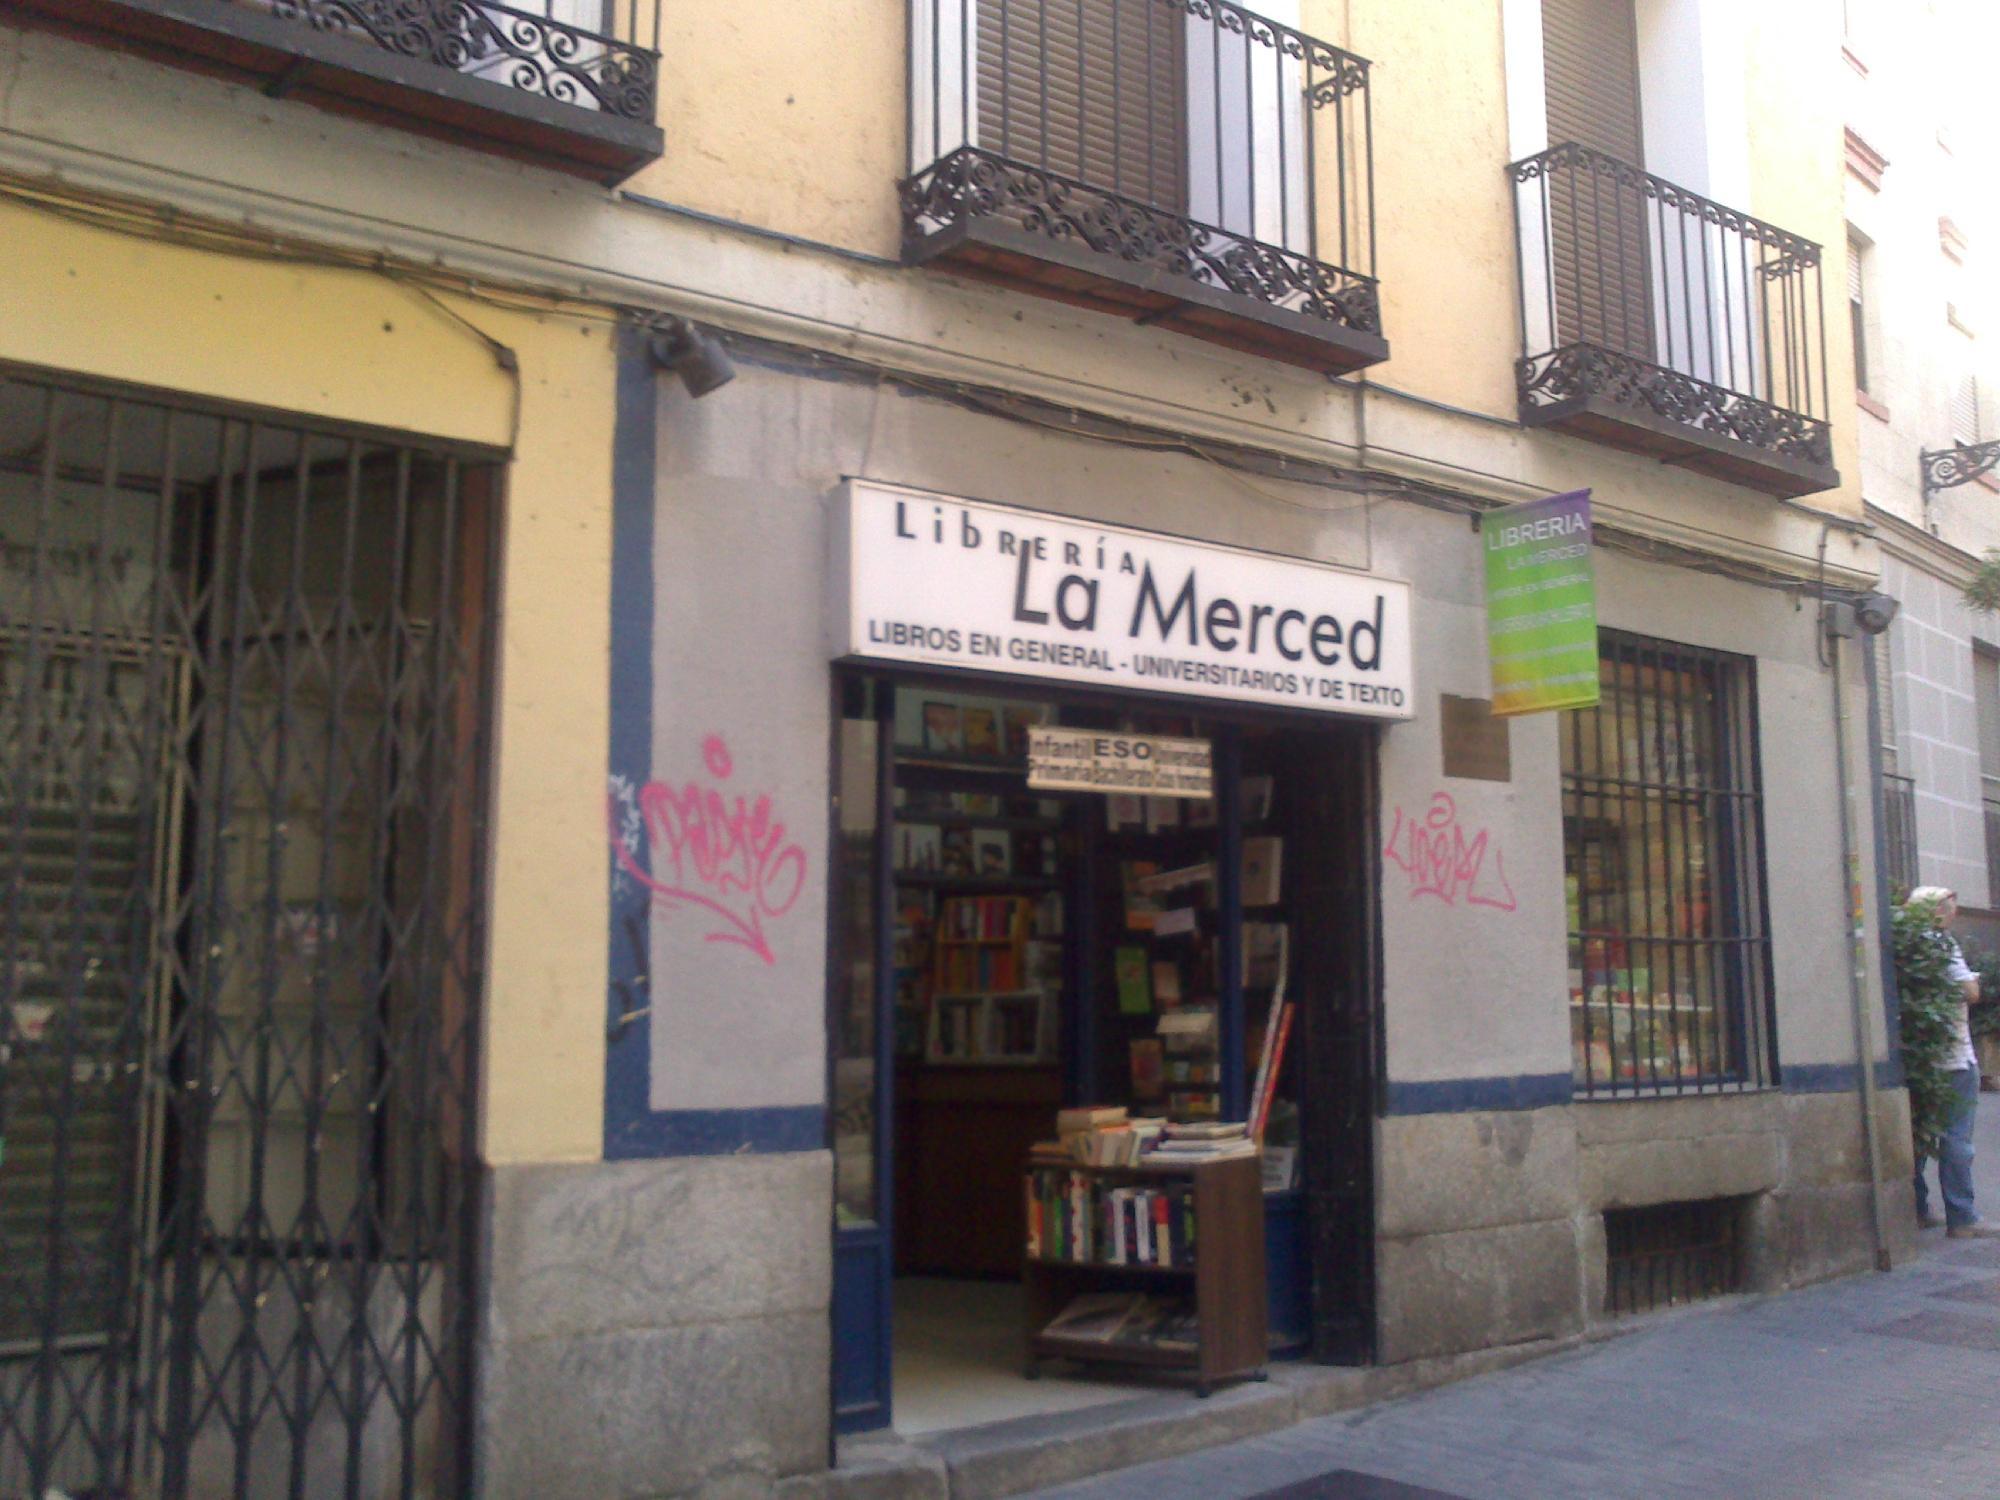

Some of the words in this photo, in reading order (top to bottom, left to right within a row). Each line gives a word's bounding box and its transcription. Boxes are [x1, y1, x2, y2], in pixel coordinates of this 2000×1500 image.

[1488, 512, 1587, 551] LIBRERIA
[1013, 539, 1099, 632] La
[1128, 559, 1384, 672] Merced
[869, 619, 962, 653] LIBROS
[968, 632, 1002, 658] EN
[1007, 637, 1115, 672] GENERAL
[1133, 653, 1298, 694] UNIVERSITARIOS
[1302, 676, 1315, 697] Y
[1318, 678, 1344, 700] DE
[1348, 682, 1405, 708] TEXTO
[1094, 738, 1152, 760] ESO
